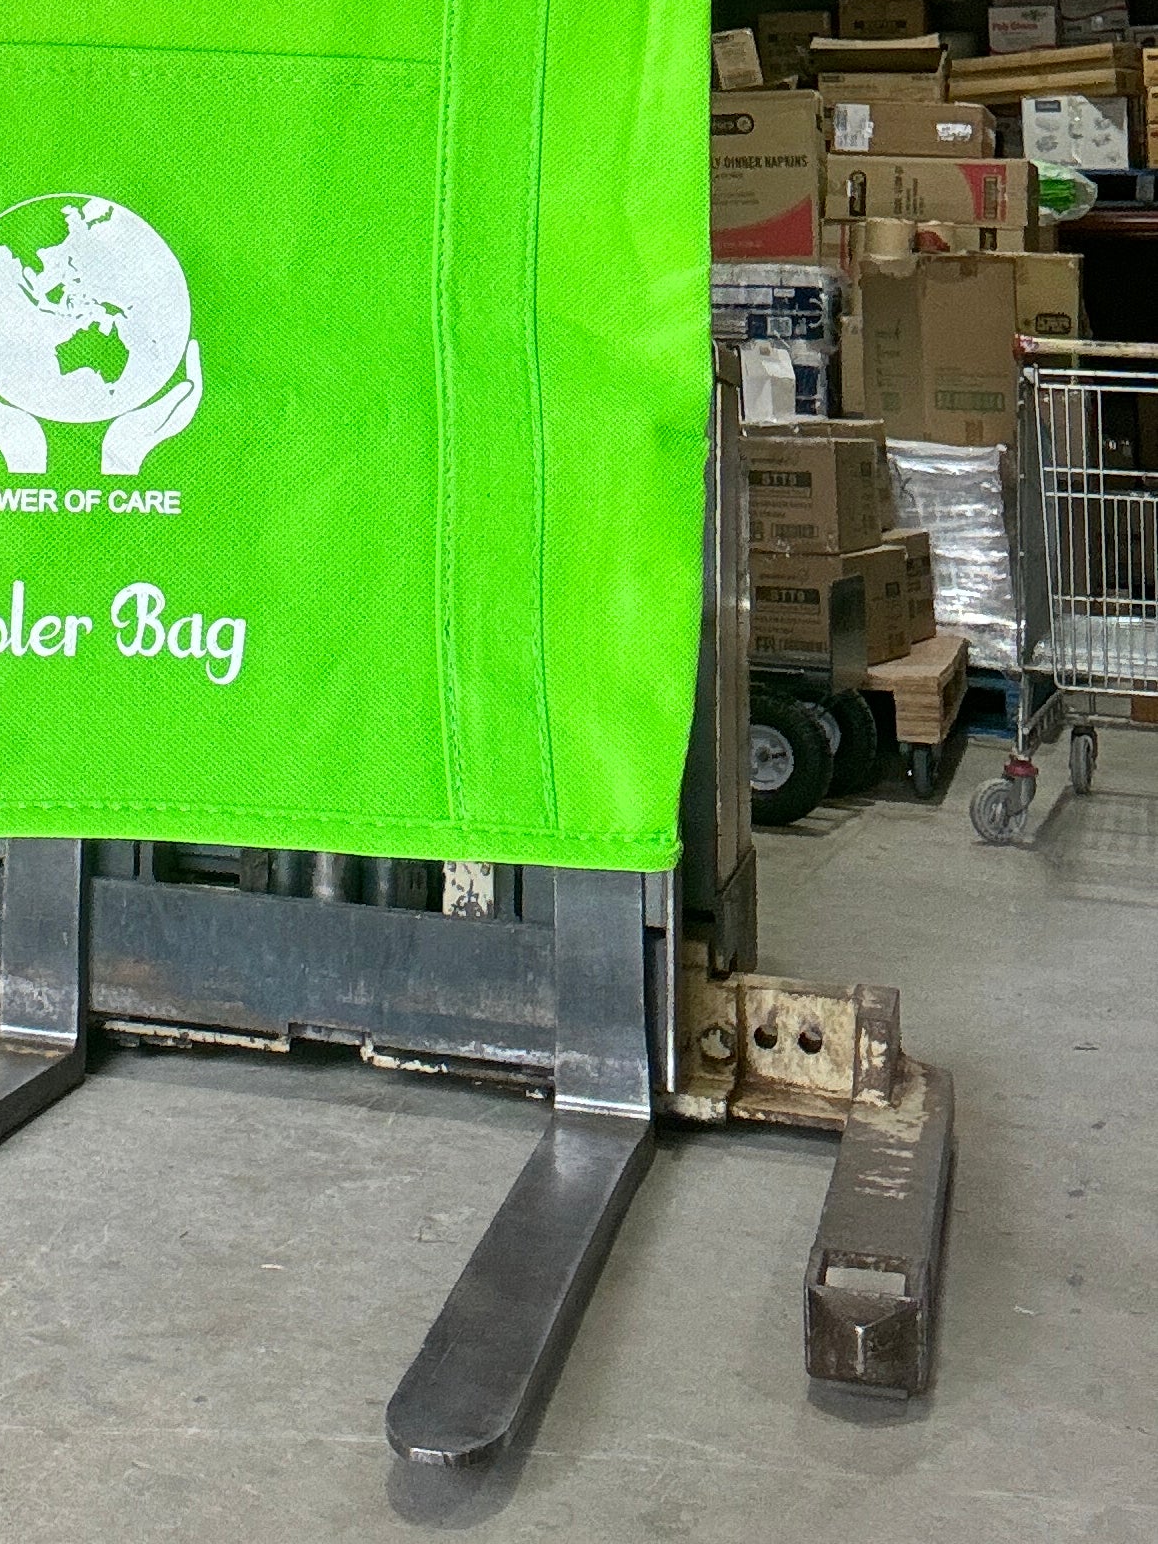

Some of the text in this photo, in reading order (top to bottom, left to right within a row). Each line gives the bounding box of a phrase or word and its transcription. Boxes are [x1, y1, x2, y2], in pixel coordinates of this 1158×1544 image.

[724, 156, 762, 169] DINNER
[765, 154, 809, 169] NAPKINS
[63, 489, 102, 513] OF
[108, 489, 182, 514] CARE
[111, 582, 248, 686] Bag
